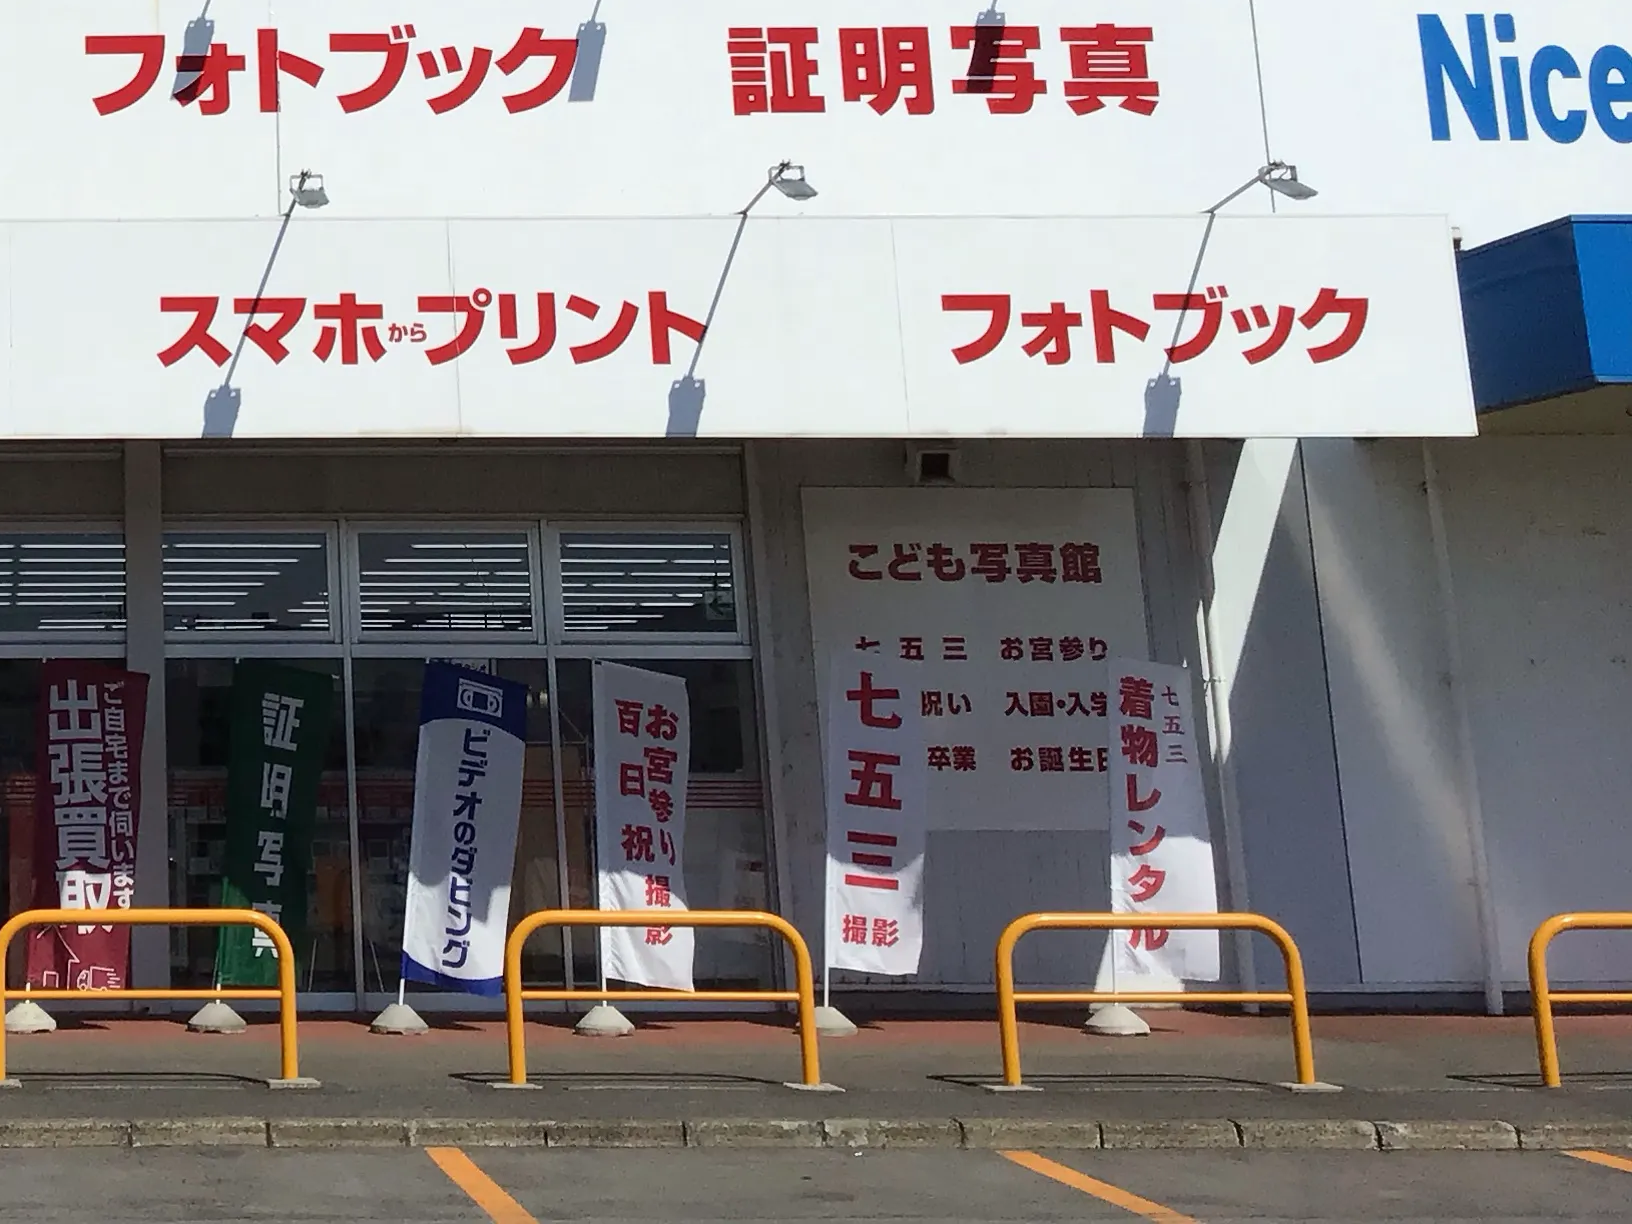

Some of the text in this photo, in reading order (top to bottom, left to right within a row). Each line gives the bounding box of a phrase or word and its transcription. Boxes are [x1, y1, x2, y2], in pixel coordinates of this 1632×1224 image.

[85, 24, 579, 116] フォトブック
[727, 23, 1159, 116] 証明写真
[157, 287, 706, 367] スマホからプリント
[941, 285, 1368, 365] フォトブック
[848, 542, 1103, 584] こども写真館
[855, 636, 1108, 662] 七五三 お宮参り
[927, 745, 977, 772] 卒業
[1161, 684, 1188, 764] 七五三
[48, 678, 113, 934] 出張買取
[103, 681, 135, 909] ご自宅まで伺います
[614, 698, 656, 863] 百日祝
[844, 671, 903, 891] 七五三
[441, 727, 491, 970] ビデオのダビング
[842, 914, 900, 948] 撮影
